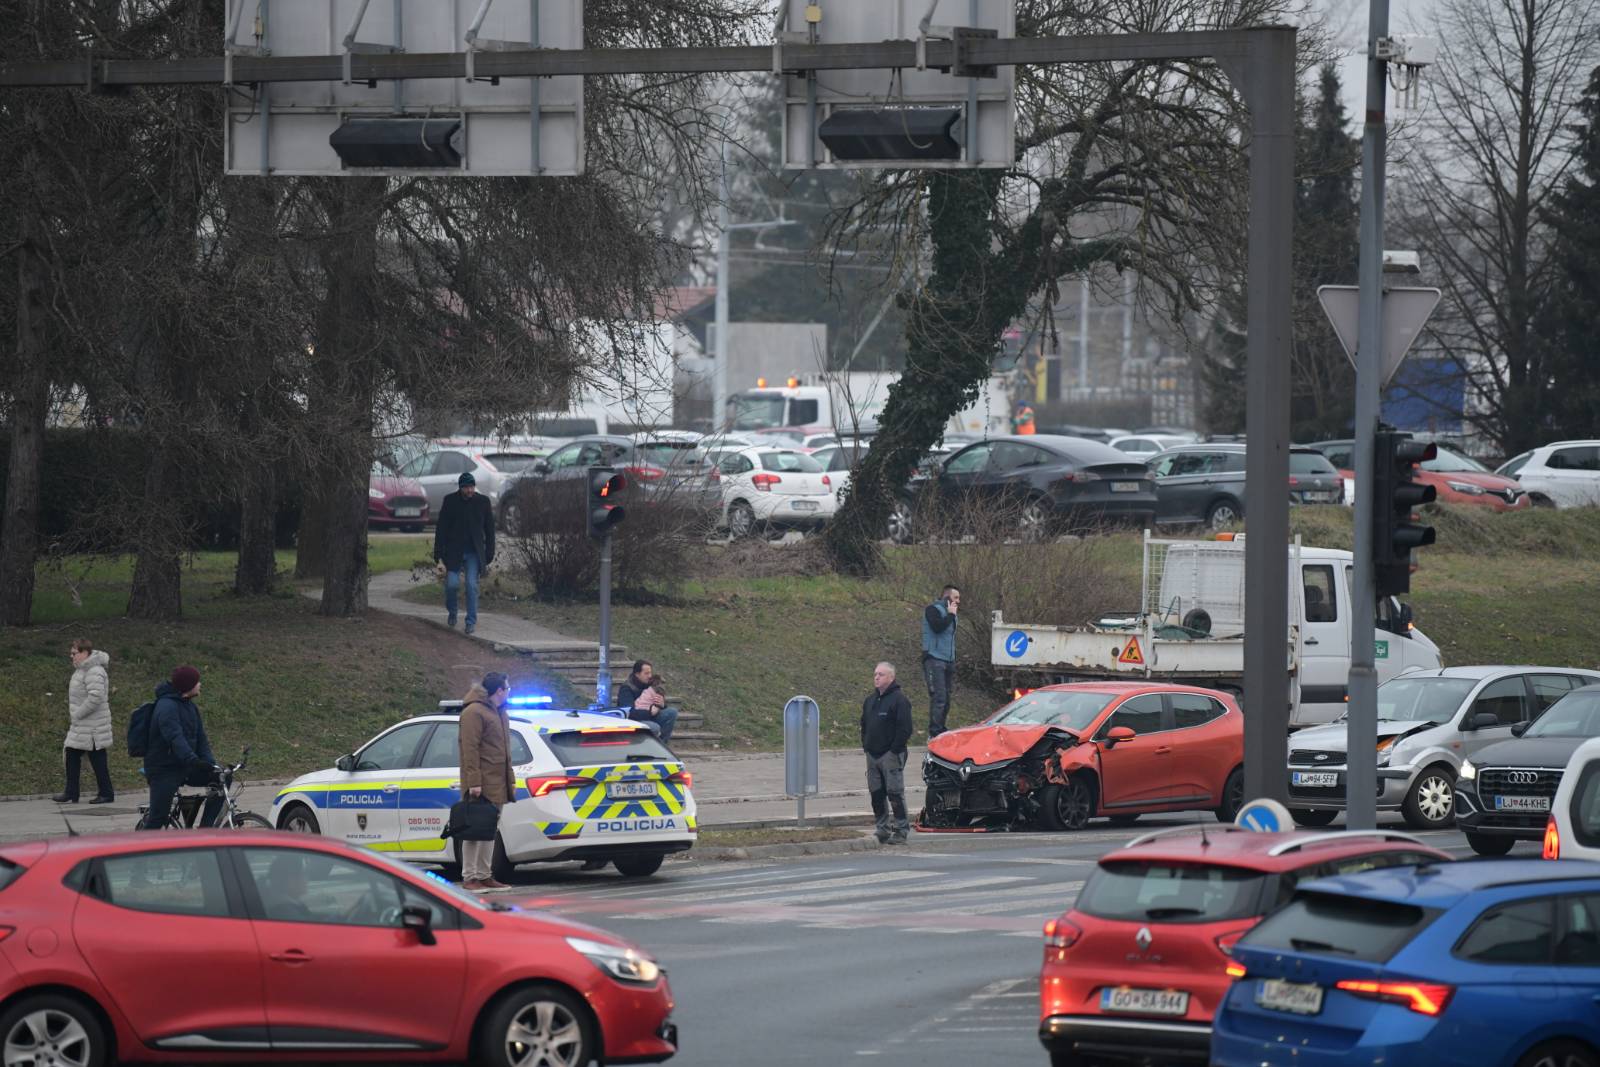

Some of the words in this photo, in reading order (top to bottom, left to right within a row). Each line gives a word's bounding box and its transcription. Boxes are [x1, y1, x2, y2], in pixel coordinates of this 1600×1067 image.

[340, 794, 383, 805] POLICIJA
[1502, 798, 1513, 808] LJ
[1518, 798, 1548, 809] 44-KHE
[597, 818, 676, 832] POLICIJA
